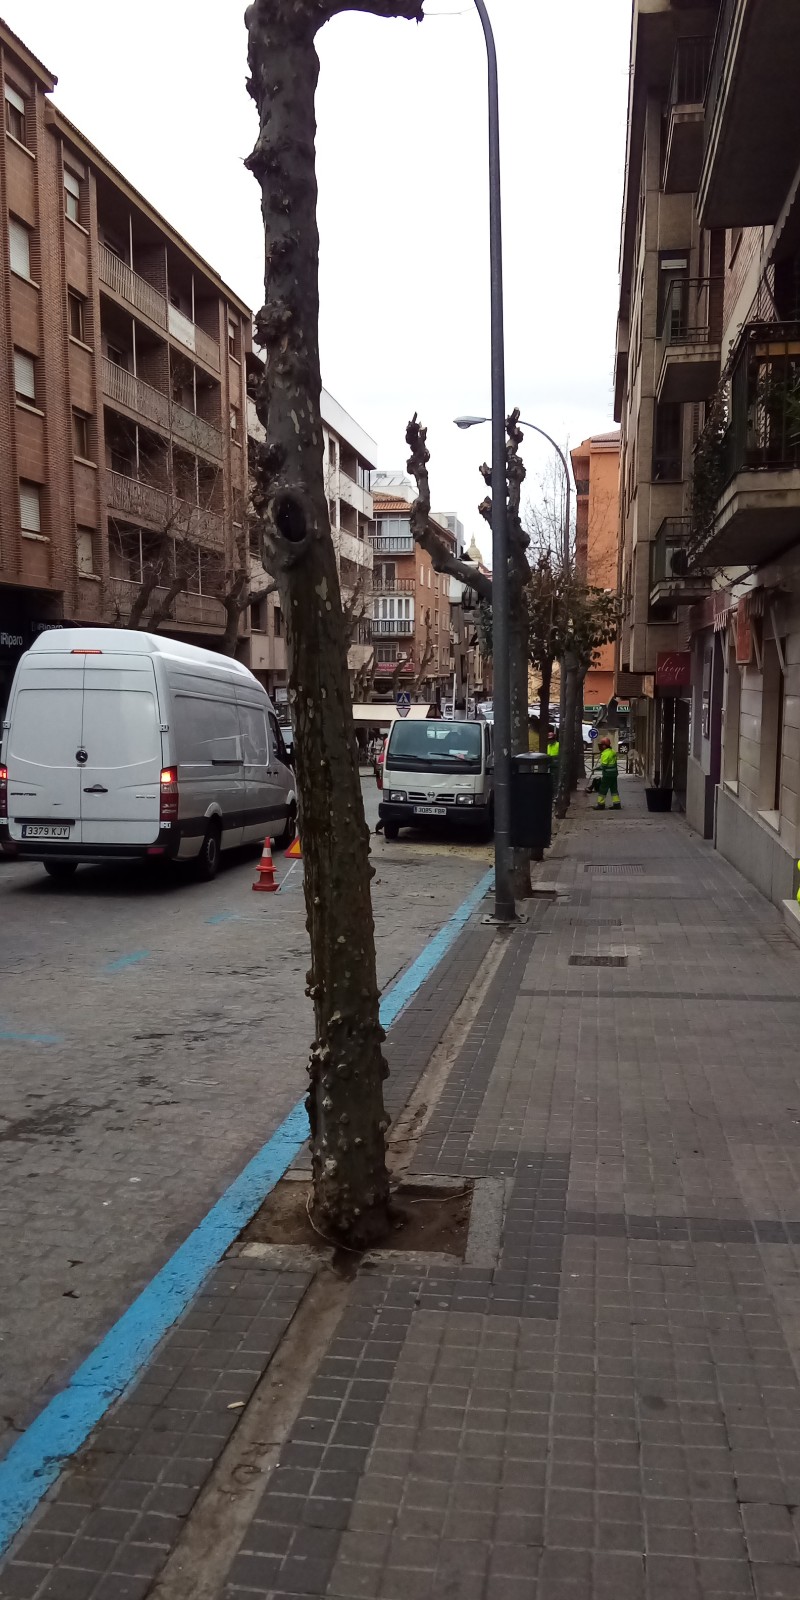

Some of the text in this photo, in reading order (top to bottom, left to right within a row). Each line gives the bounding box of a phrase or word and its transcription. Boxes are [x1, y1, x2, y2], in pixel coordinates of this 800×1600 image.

[1, 632, 23, 648] iRiparo
[27, 826, 68, 836] 3379 KJY
